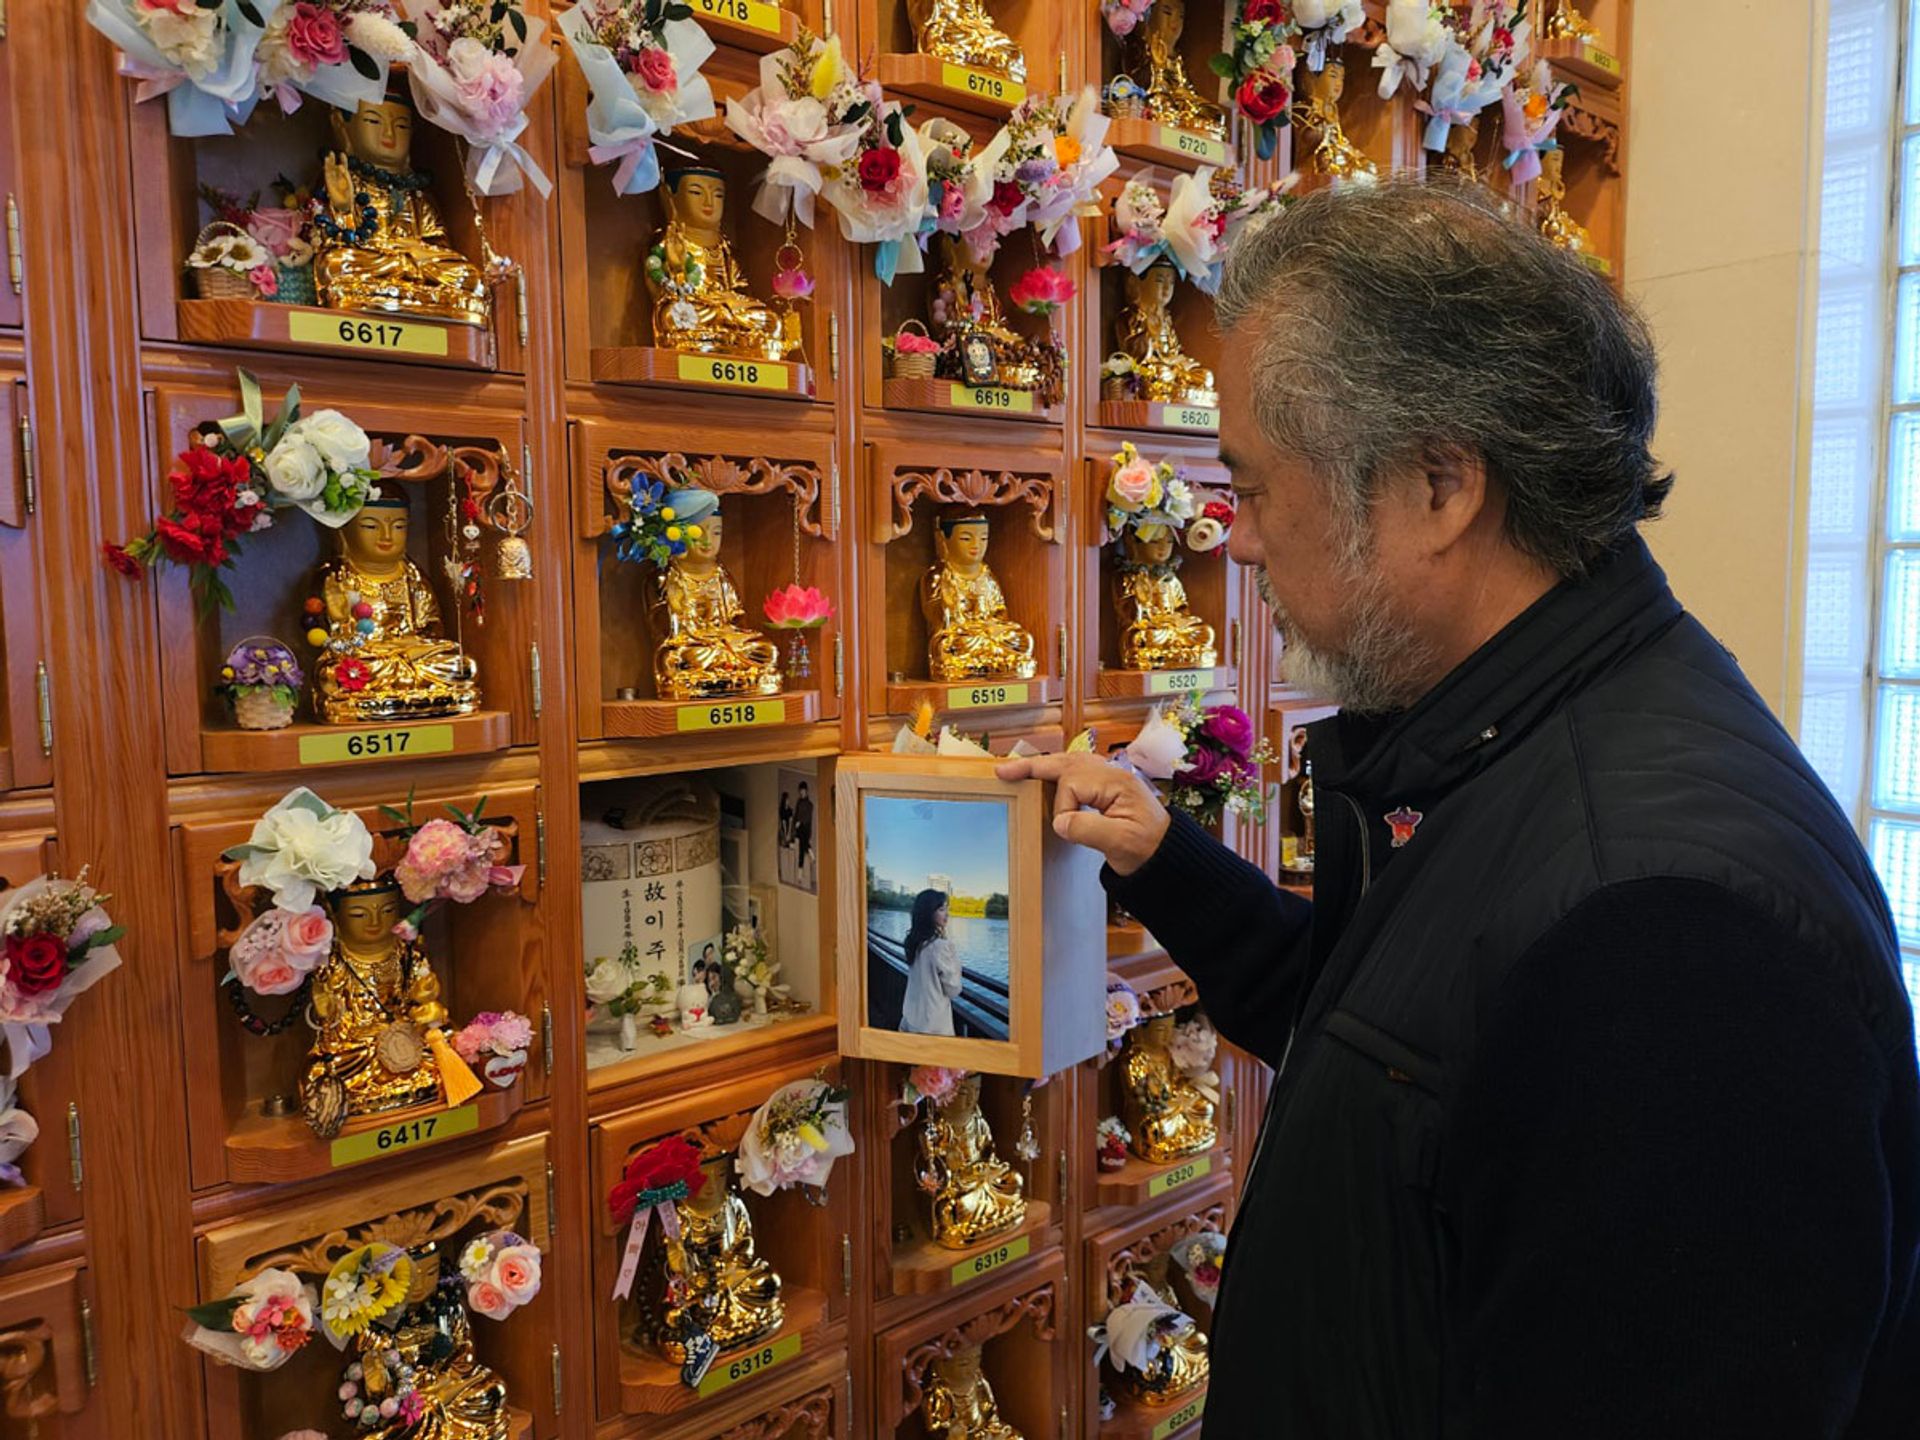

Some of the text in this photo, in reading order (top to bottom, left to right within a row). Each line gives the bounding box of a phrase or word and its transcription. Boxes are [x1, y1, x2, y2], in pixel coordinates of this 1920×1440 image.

[703, 0, 748, 20] 6718
[968, 74, 1003, 97] 6719
[1178, 135, 1207, 156] 6720
[338, 320, 403, 347] 6617
[711, 362, 758, 384] 6618
[975, 389, 1010, 406] 6619
[1181, 410, 1209, 425] 6620
[1168, 673, 1198, 690] 6520
[970, 688, 1006, 706] 6519
[710, 705, 755, 725] 6518
[347, 732, 411, 756] 6517
[377, 1118, 437, 1149] 6417
[1165, 1165, 1194, 1187] 6320
[974, 1245, 1008, 1273] 6319
[729, 1348, 773, 1379] 6318
[1169, 1405, 1196, 1430] 6220
